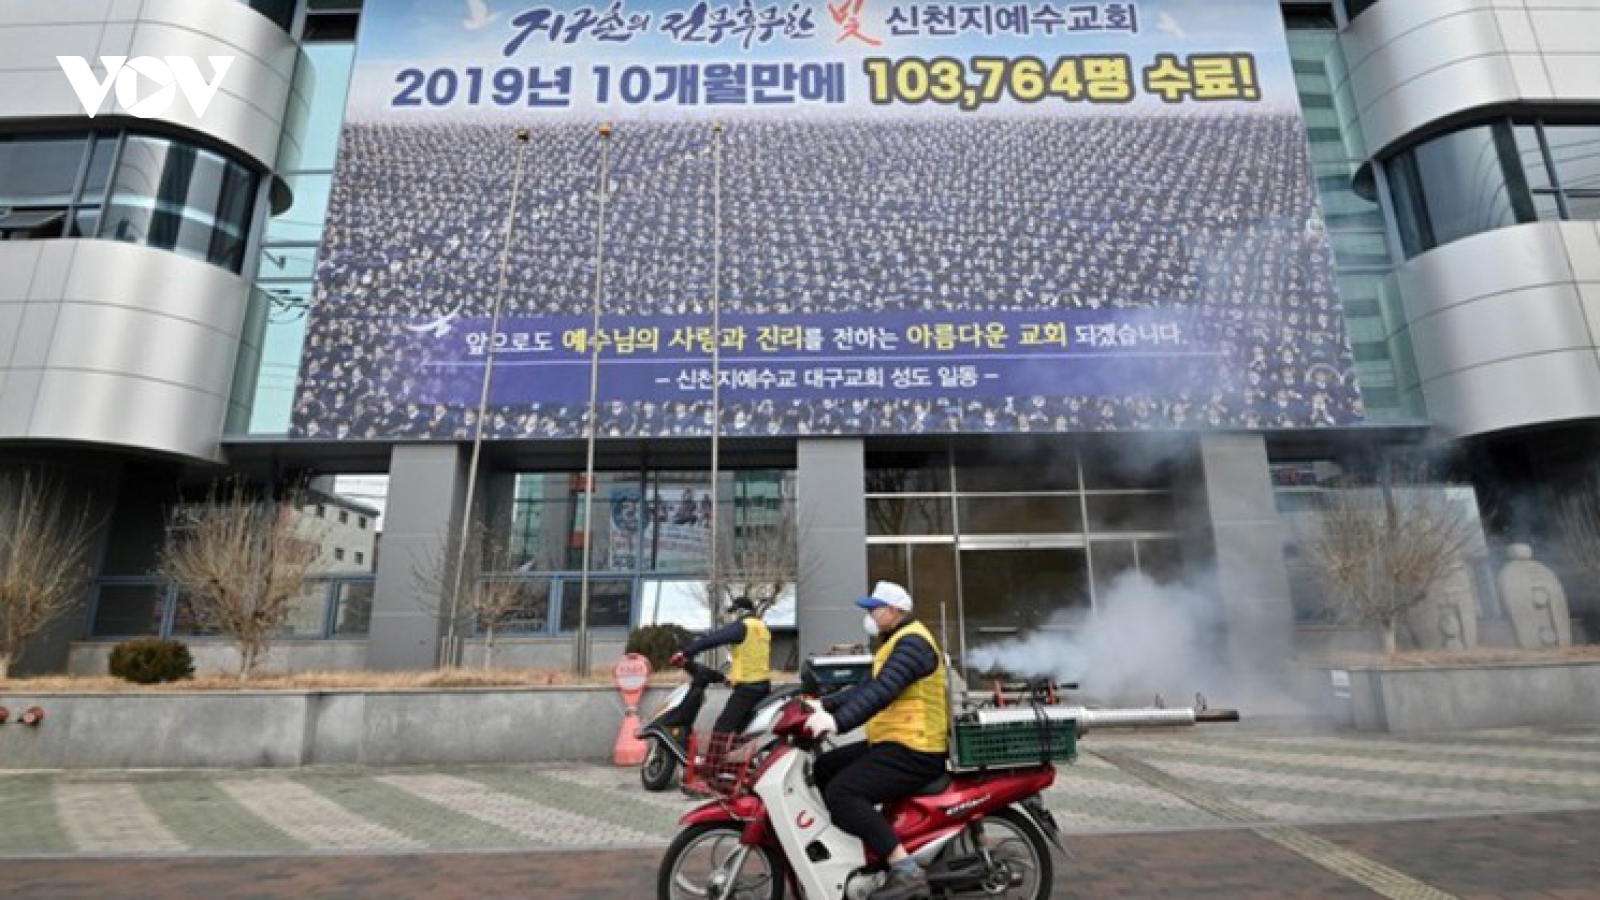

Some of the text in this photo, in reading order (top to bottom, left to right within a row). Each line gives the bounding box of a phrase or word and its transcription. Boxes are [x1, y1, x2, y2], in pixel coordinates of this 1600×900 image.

[828, 0, 882, 46] 빛
[885, 3, 1138, 36] 신천지예수교회
[391, 53, 1261, 110] 2019년 10개월만에 103,764명 수료!
[465, 330, 554, 355] 앞으로도
[562, 326, 660, 354] 예수님의
[667, 325, 748, 353] 사랑과
[756, 324, 826, 352] 진리를
[832, 327, 899, 350] 전하는
[906, 321, 1009, 350] 아름다운
[1018, 321, 1068, 348] 교회
[676, 367, 798, 391] 신천지예수교
[803, 366, 885, 389] 대구교회
[891, 365, 931, 389] 성도
[938, 365, 979, 388] 일동
